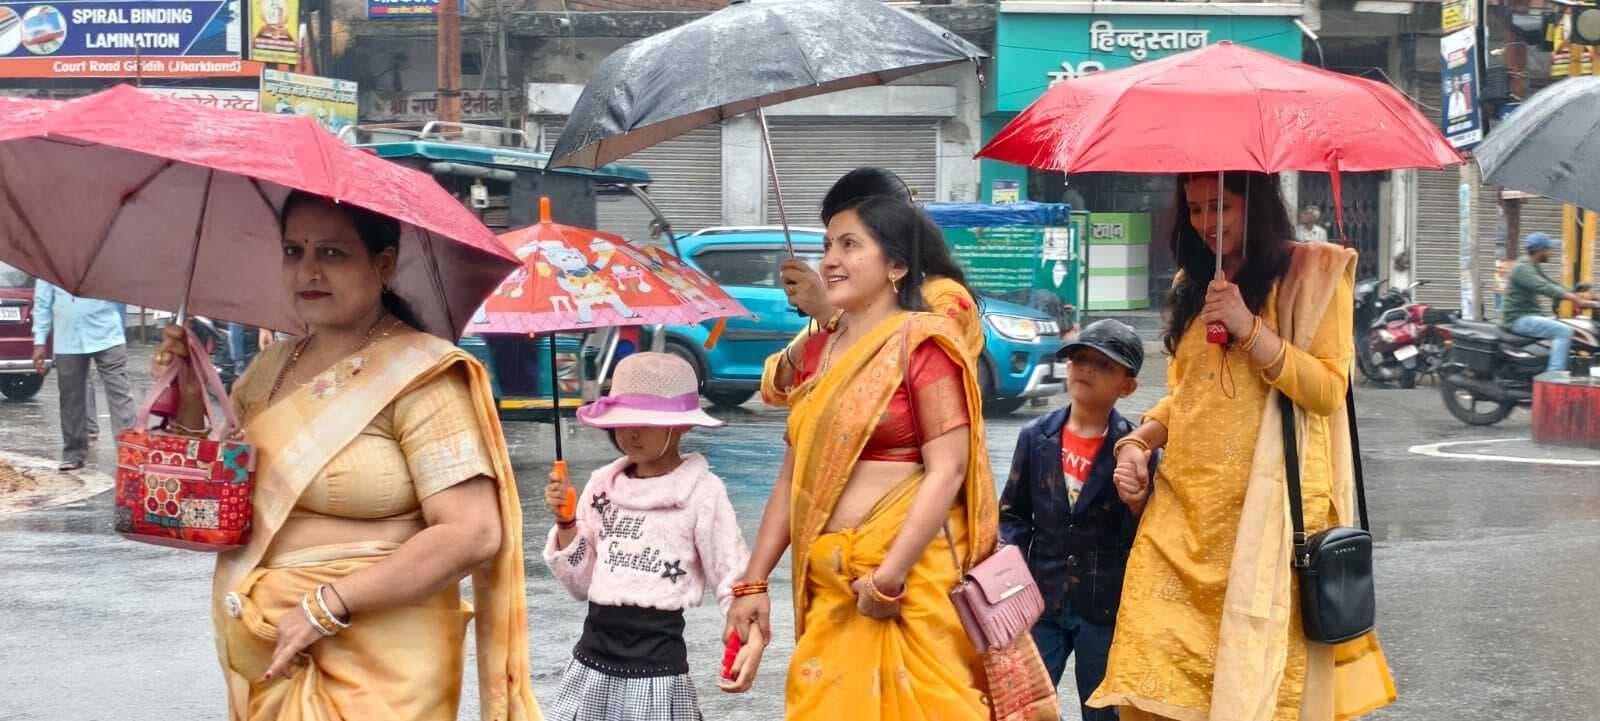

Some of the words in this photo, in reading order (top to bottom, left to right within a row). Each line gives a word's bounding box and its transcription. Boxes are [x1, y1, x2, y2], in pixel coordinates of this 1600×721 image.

[72, 8, 128, 25] SPIRAL
[131, 8, 193, 24] BINDING
[86, 32, 180, 48] LAMINATION
[1090, 20, 1209, 60] हिन्दुस्तान
[53, 61, 85, 72] Court
[89, 60, 120, 72] Road
[168, 60, 242, 73] (Jharkhand)
